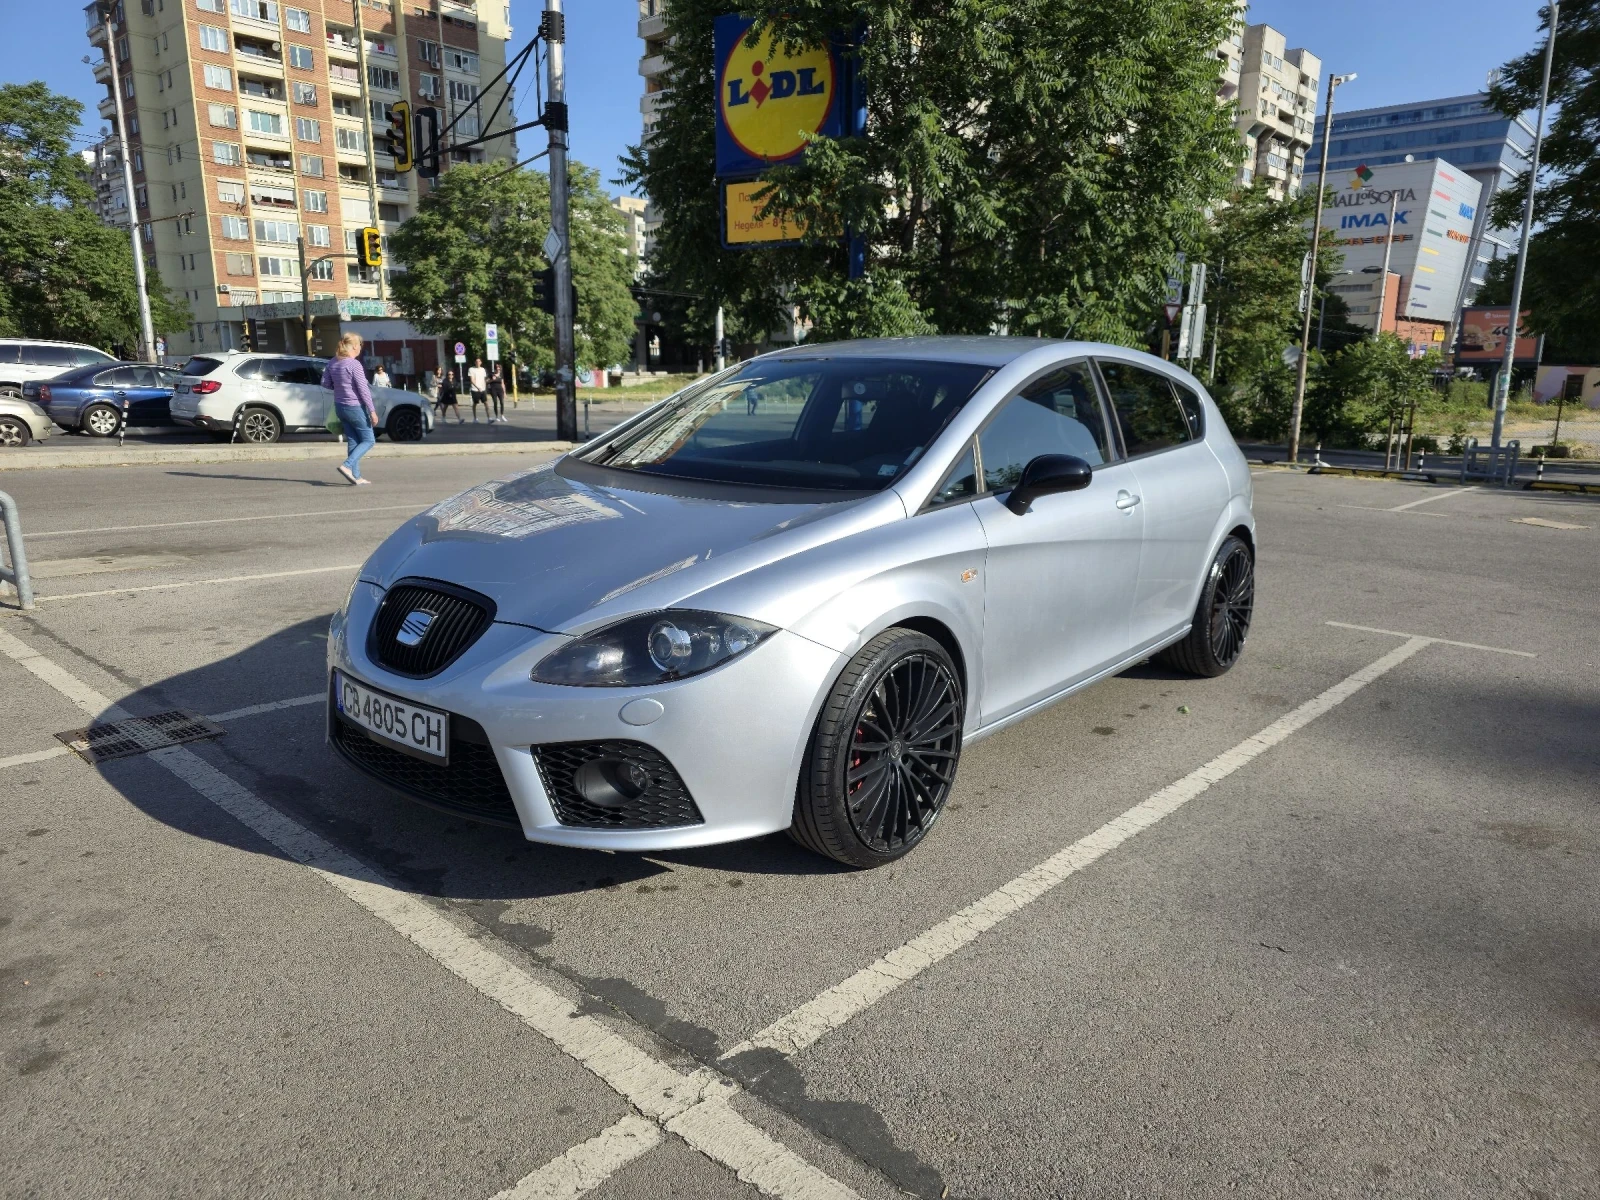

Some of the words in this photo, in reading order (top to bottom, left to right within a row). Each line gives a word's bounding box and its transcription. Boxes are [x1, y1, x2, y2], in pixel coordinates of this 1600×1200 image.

[1369, 187, 1417, 205] SOFIA
[734, 220, 764, 232] Неделя
[1341, 210, 1408, 229] IMAX
[363, 694, 408, 739] 4805
[411, 712, 442, 752] CH
